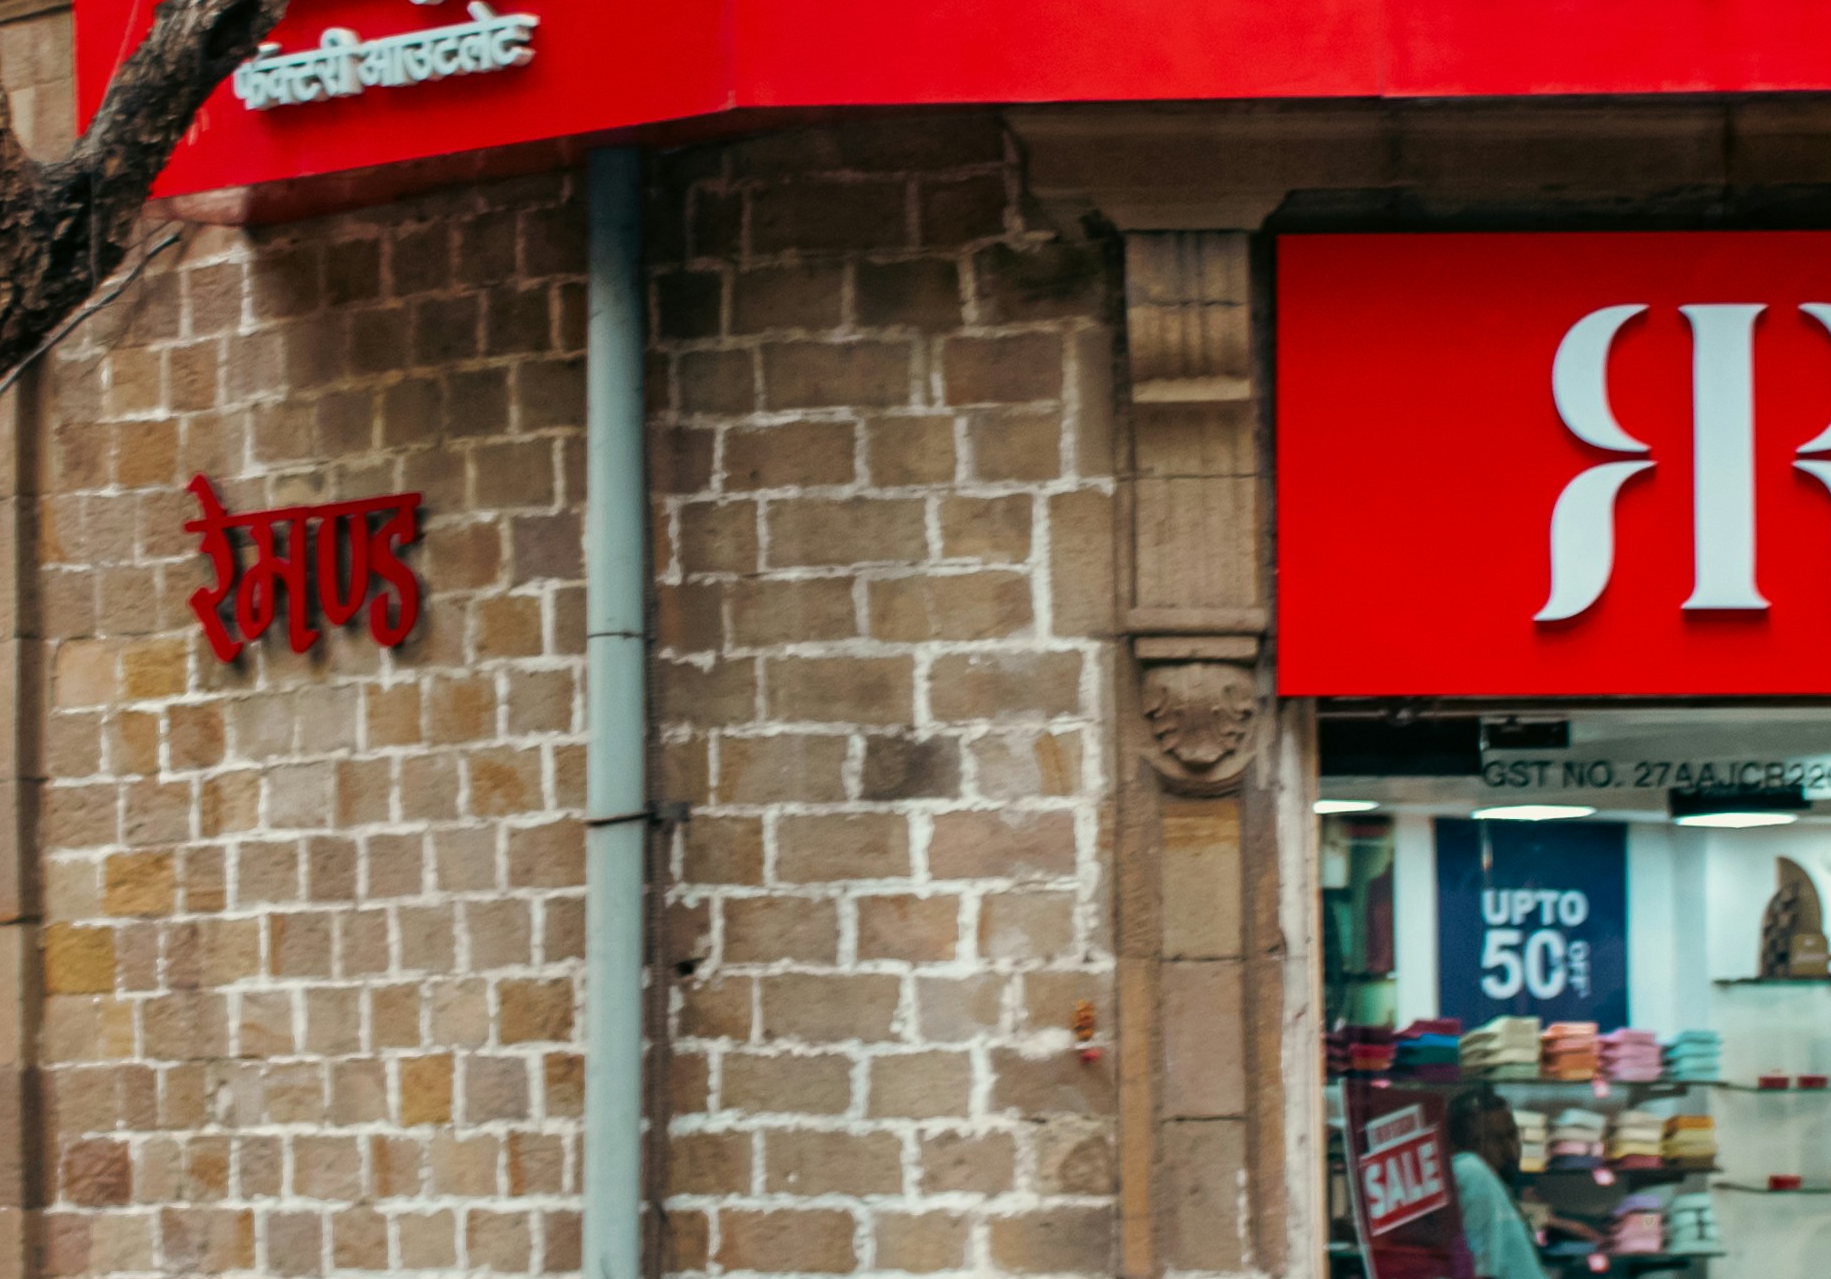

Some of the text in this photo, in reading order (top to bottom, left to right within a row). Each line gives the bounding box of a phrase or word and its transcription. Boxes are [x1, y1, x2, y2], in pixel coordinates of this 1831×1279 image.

[184, 473, 424, 664] रेमण्ड
[1482, 759, 1552, 788] GST
[1562, 760, 1622, 789] NO.
[1481, 888, 1589, 927] UPTO
[1481, 928, 1567, 1000] 50
[1364, 1141, 1443, 1221] SALE
